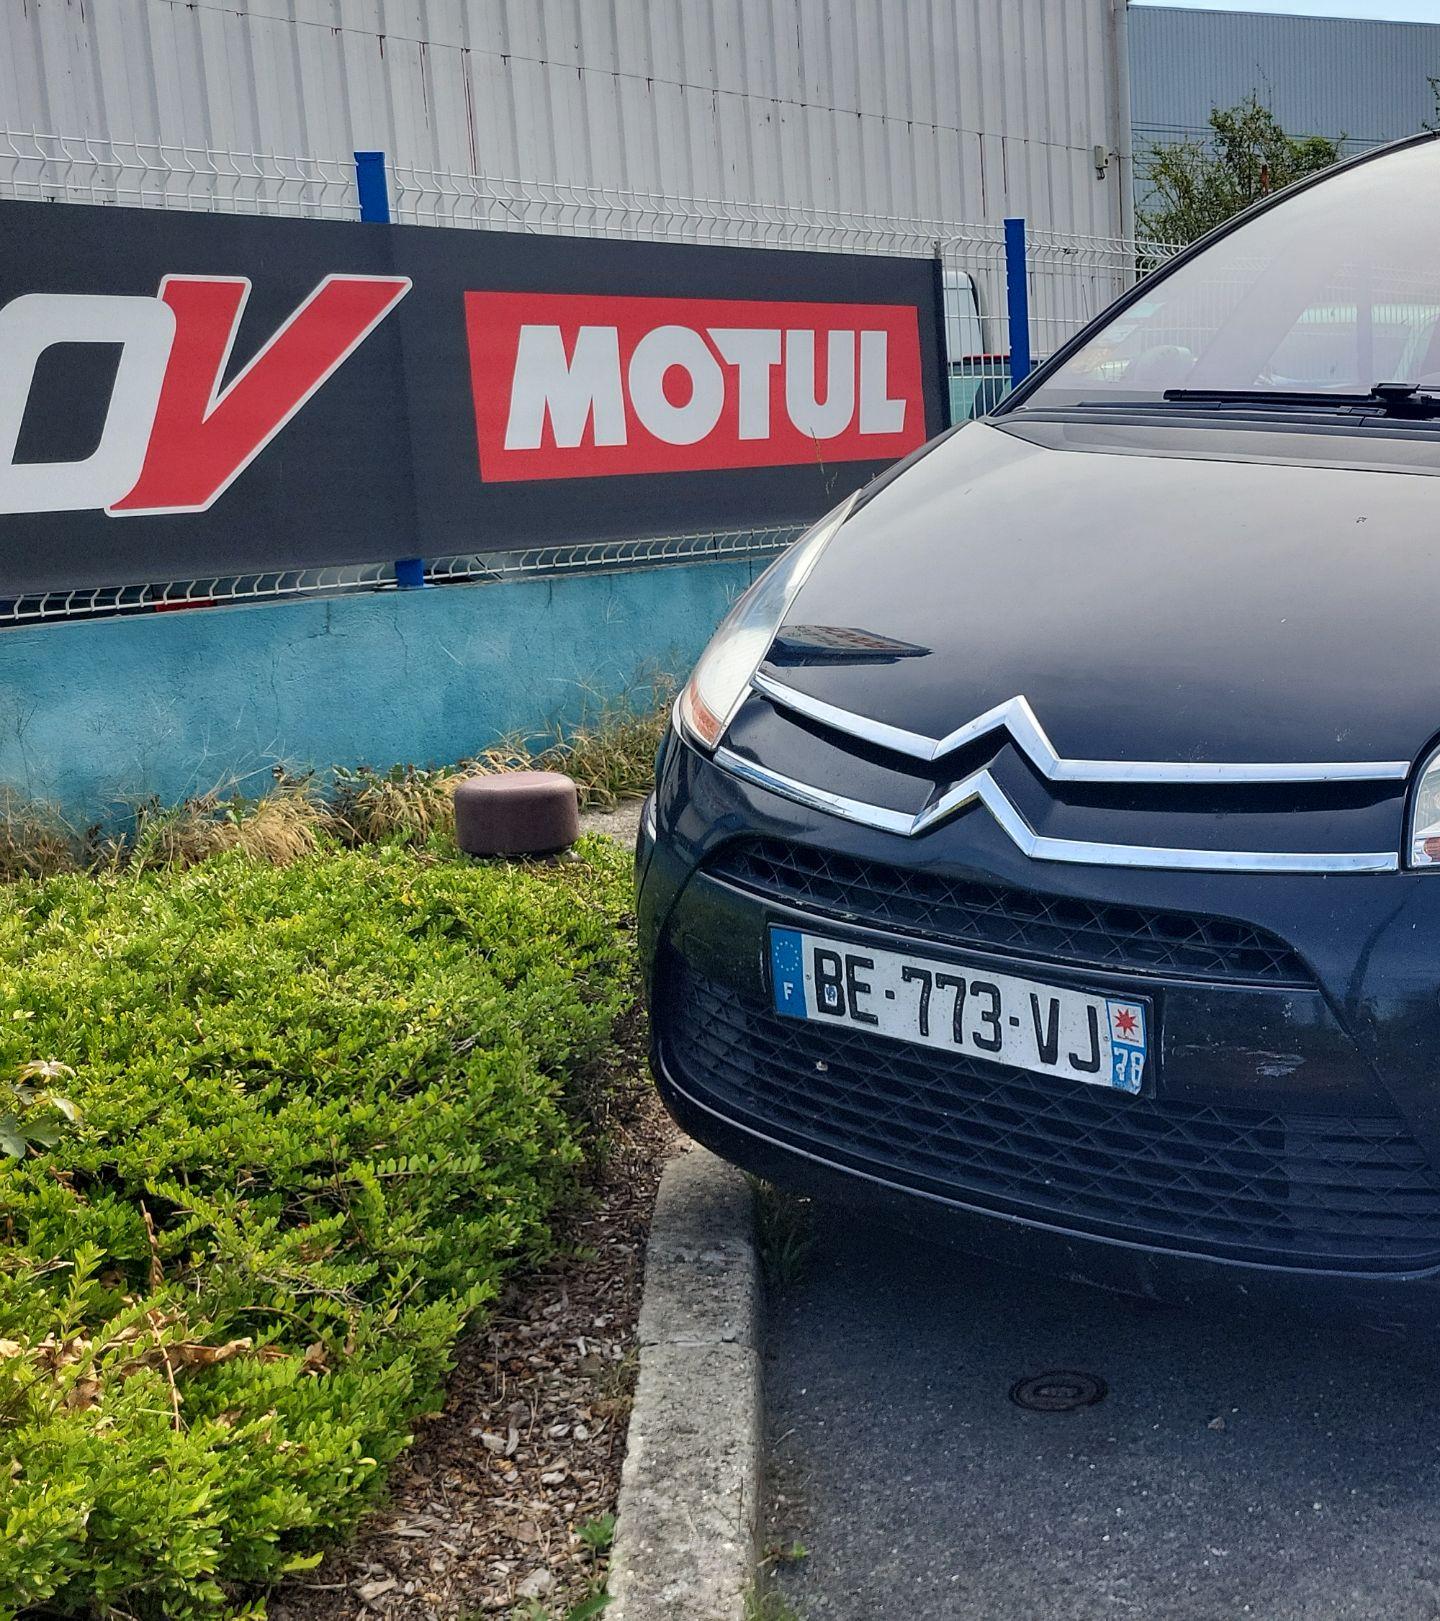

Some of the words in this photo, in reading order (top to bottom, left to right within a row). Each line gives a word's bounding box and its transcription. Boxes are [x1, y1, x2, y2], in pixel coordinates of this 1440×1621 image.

[503, 324, 907, 451] MOTUL
[783, 981, 794, 1001] F
[813, 946, 1101, 1074] BE-773-VJ
